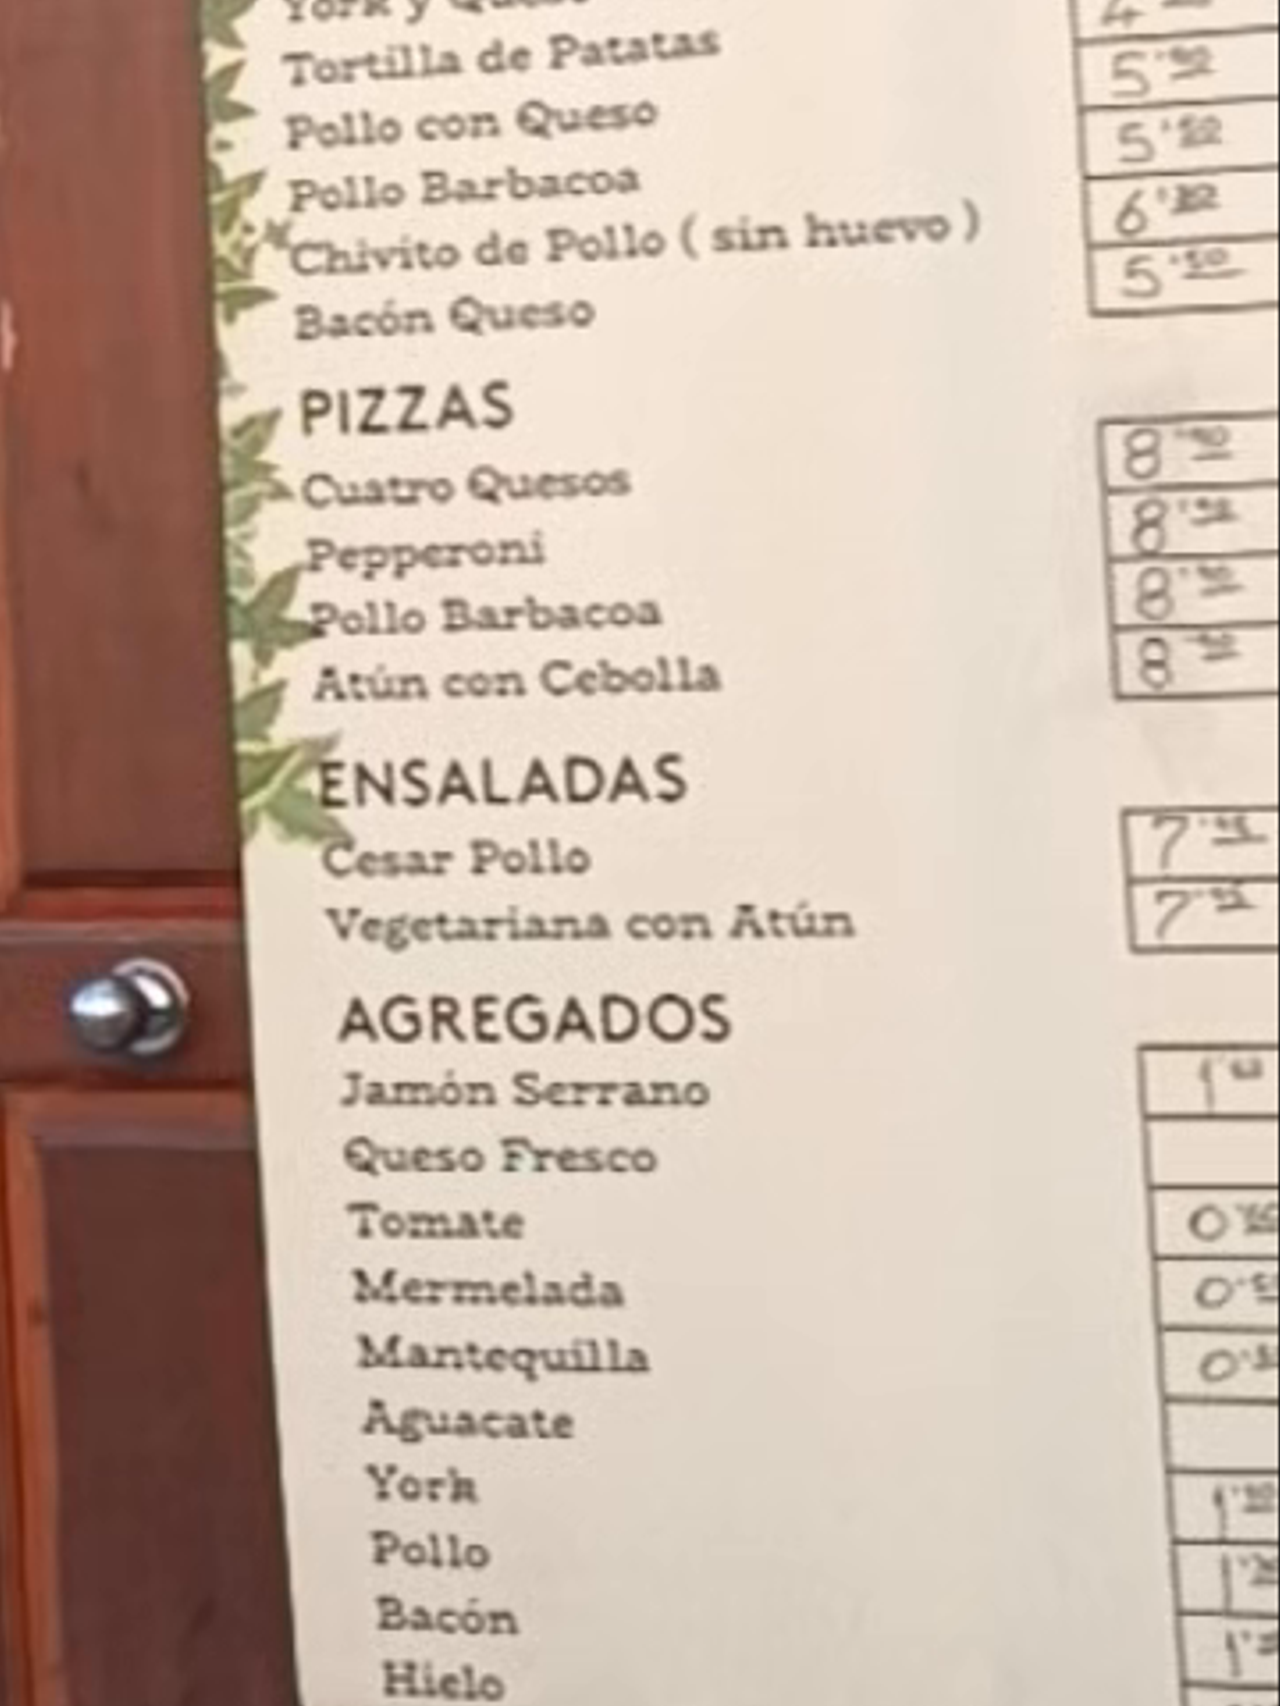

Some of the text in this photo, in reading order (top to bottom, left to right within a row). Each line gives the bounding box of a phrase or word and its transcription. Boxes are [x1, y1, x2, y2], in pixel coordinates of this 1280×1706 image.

[279, 28, 723, 89] Tortilla de Patatas
[282, 98, 660, 153] Pollo con Queso
[286, 164, 643, 215] Pollo Barbacoa
[288, 234, 463, 278] Chivito
[472, 228, 530, 268] de
[543, 221, 668, 265] Pollo
[711, 215, 792, 254] sin
[802, 210, 953, 250] huevo
[292, 293, 598, 343] Bacón Queso
[299, 378, 515, 438] PIZZAS
[299, 463, 633, 512] Cuatro Quesos
[305, 531, 548, 581] Pepperoni
[308, 593, 665, 637] Pollo Barbacoa
[311, 654, 724, 704] Atún con Cebolla
[318, 753, 689, 809] ENSALADAS
[320, 836, 593, 880] Cesar Pollo
[323, 900, 857, 955] Vegetariana con Atún
[337, 991, 733, 1045] AGREGADOS
[338, 1068, 712, 1109] Jamón Serrano
[341, 1134, 659, 1179] Queso Fresco
[344, 1199, 526, 1241] Tomate
[350, 1266, 627, 1310] Mermelada
[355, 1332, 652, 1384] Mantequilla
[359, 1397, 576, 1446] Aguacate
[363, 1462, 480, 1506] York
[368, 1528, 492, 1572] Pollo
[373, 1593, 521, 1637] Bacón
[380, 1658, 506, 1703] Hielo
